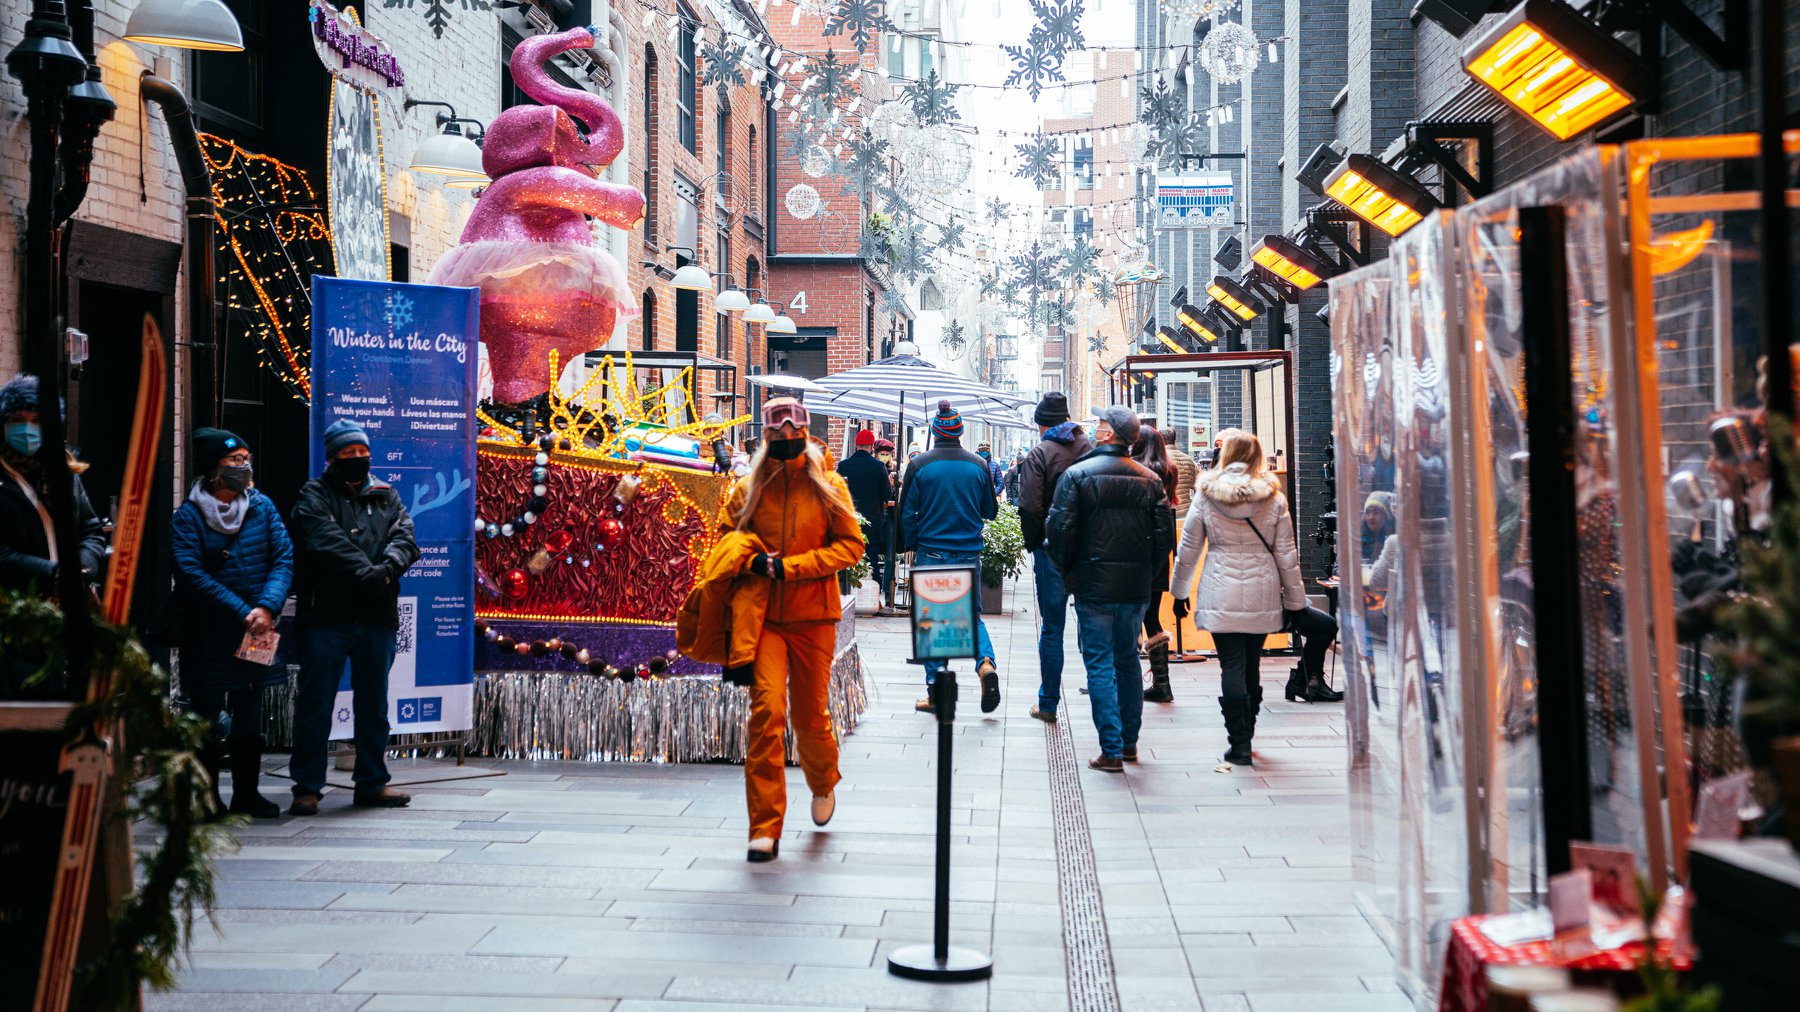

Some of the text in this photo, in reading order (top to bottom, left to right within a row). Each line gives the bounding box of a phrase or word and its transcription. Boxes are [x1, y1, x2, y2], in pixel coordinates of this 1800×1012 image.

[790, 291, 809, 314] 4
[328, 327, 467, 363] Winter in the City
[363, 353, 432, 364] Downtown Denver
[341, 394, 361, 403] Wear
[368, 396, 387, 404] mask
[410, 397, 459, 407] Use máscara
[333, 407, 394, 417] Wash your hands
[401, 409, 427, 418] Lávese
[429, 410, 440, 418] las
[366, 419, 382, 428] fun!
[387, 453, 403, 461] 6FT
[388, 474, 401, 482] 2M
[423, 569, 442, 577] code
